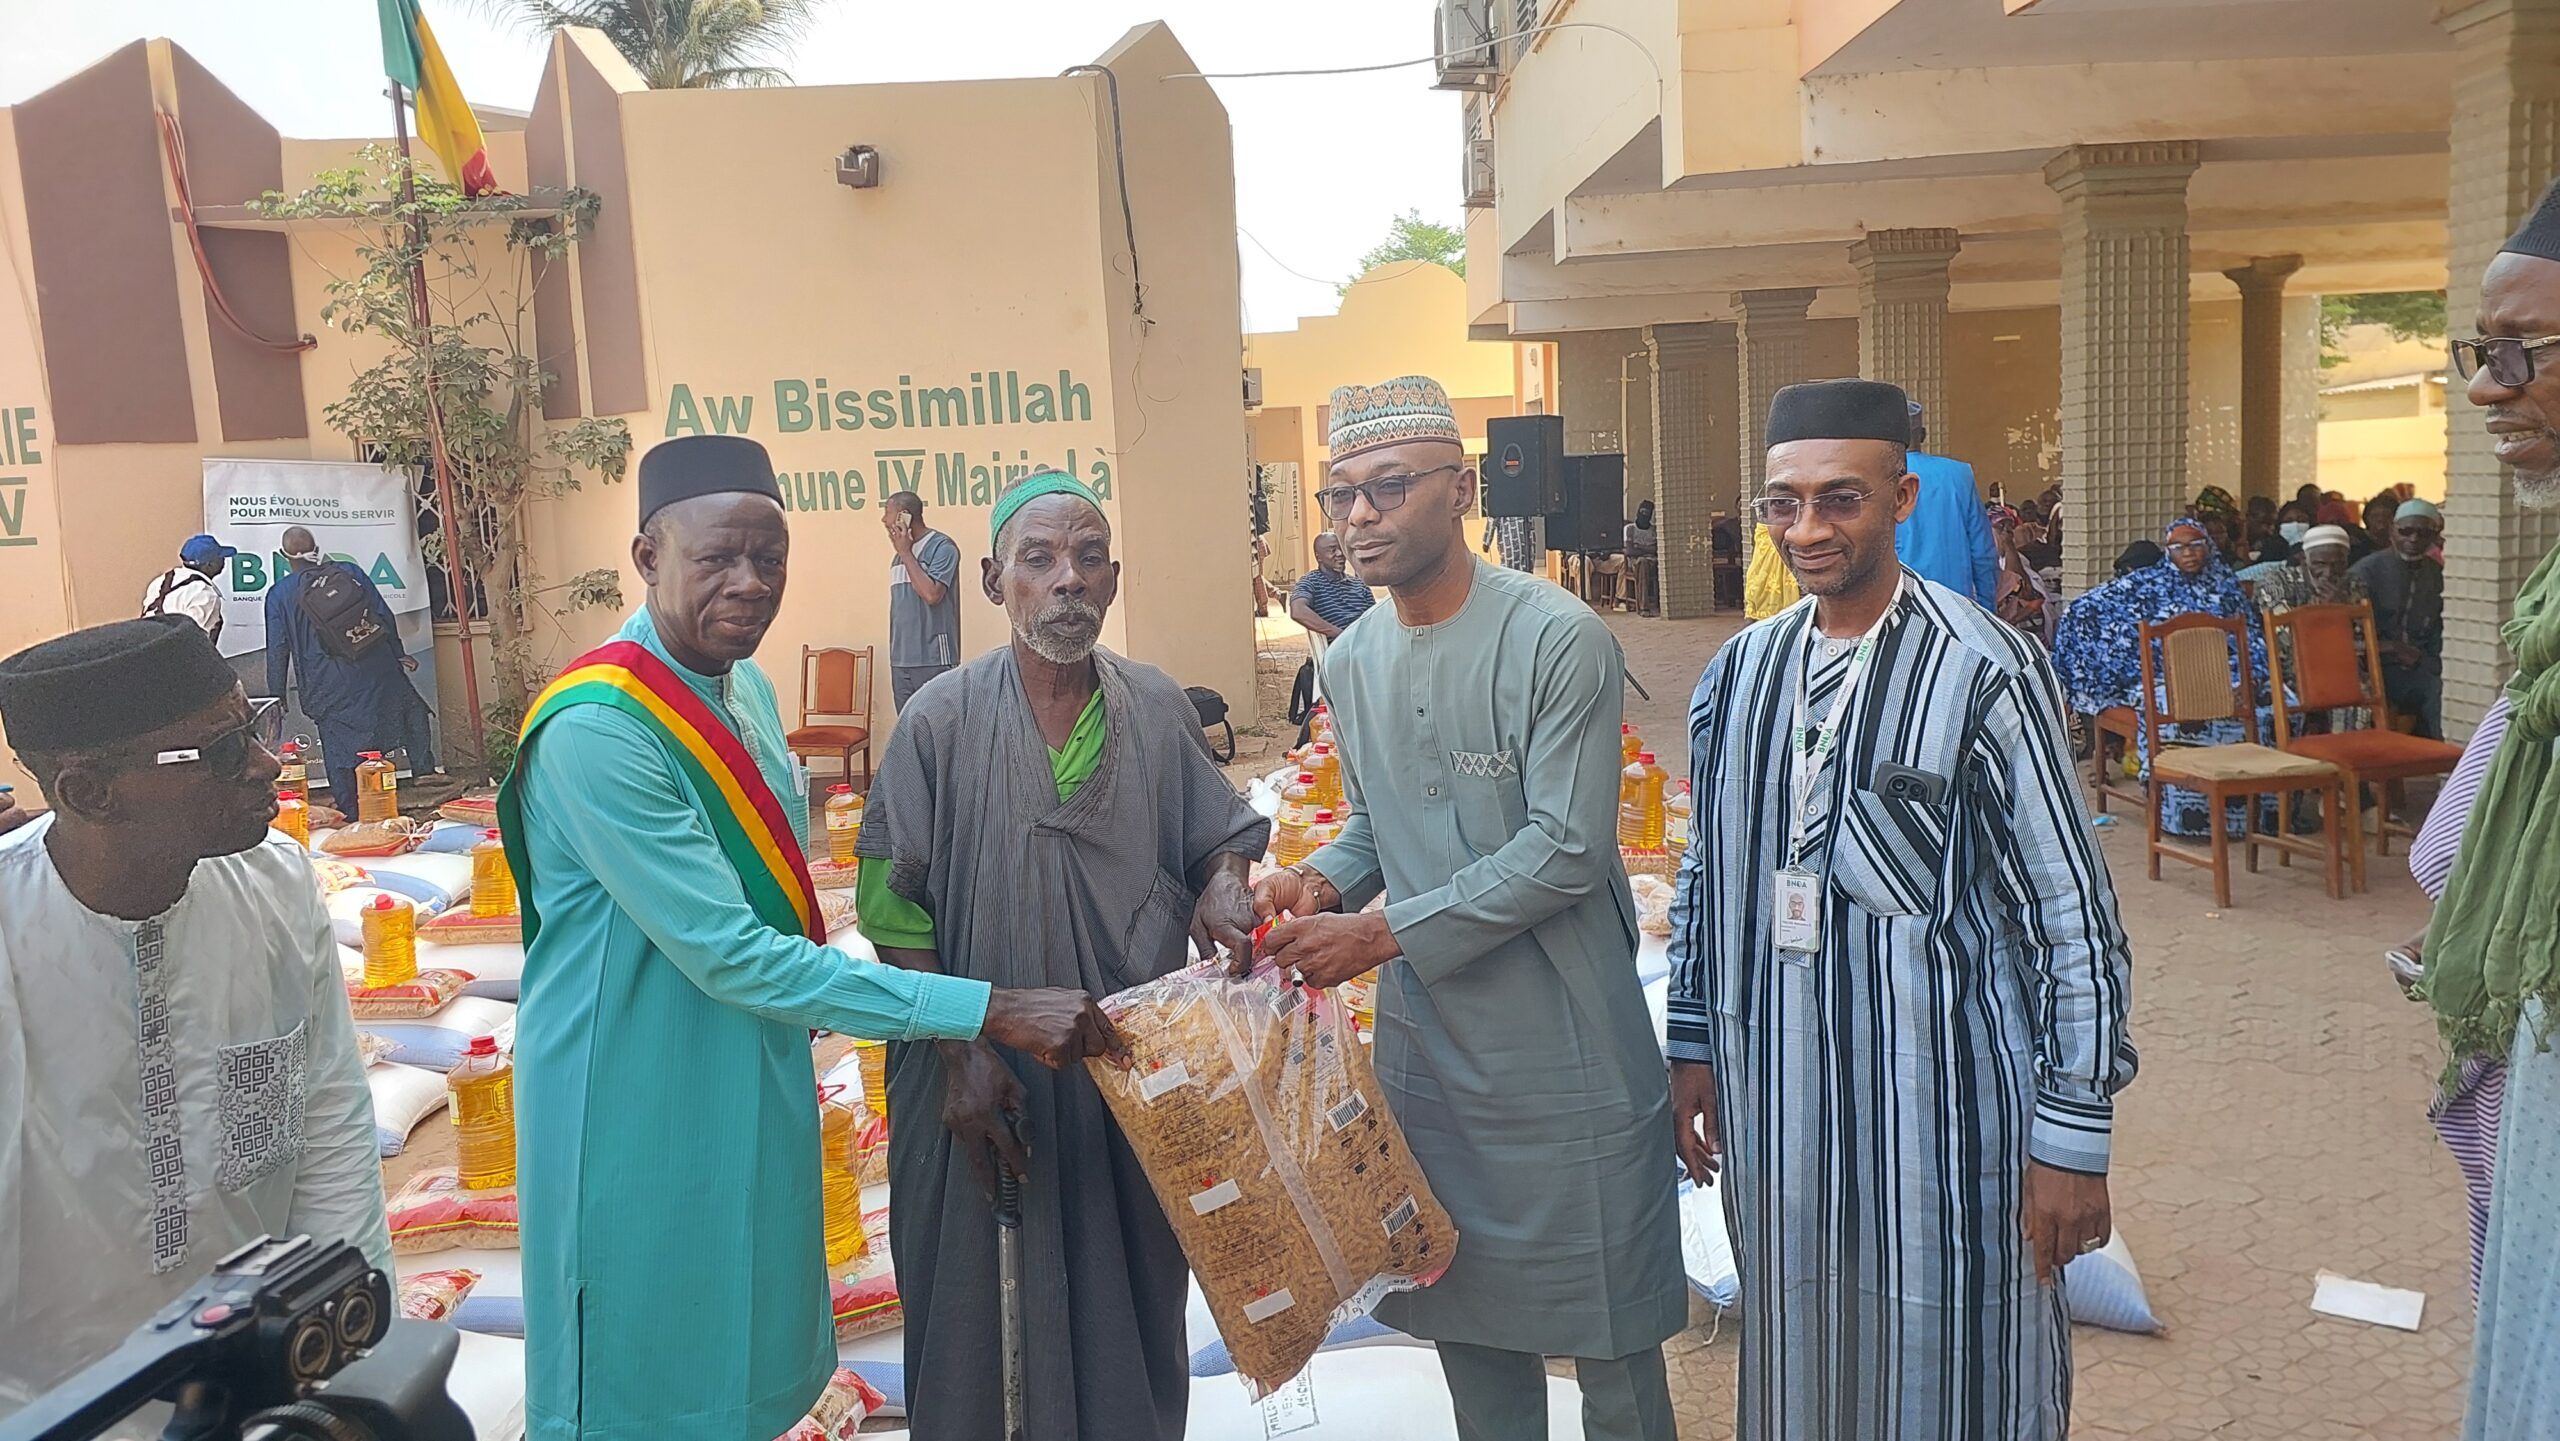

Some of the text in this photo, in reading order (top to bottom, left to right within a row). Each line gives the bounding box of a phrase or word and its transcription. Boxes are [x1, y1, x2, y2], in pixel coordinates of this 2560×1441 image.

[665, 369, 1092, 437] Aw Bissimillah
[0, 407, 42, 465] IE
[230, 494, 339, 508] NOUS ÉVOLUONS
[874, 449, 928, 507] IV
[230, 508, 396, 519] POUR MIEUX VOUS SERVIR
